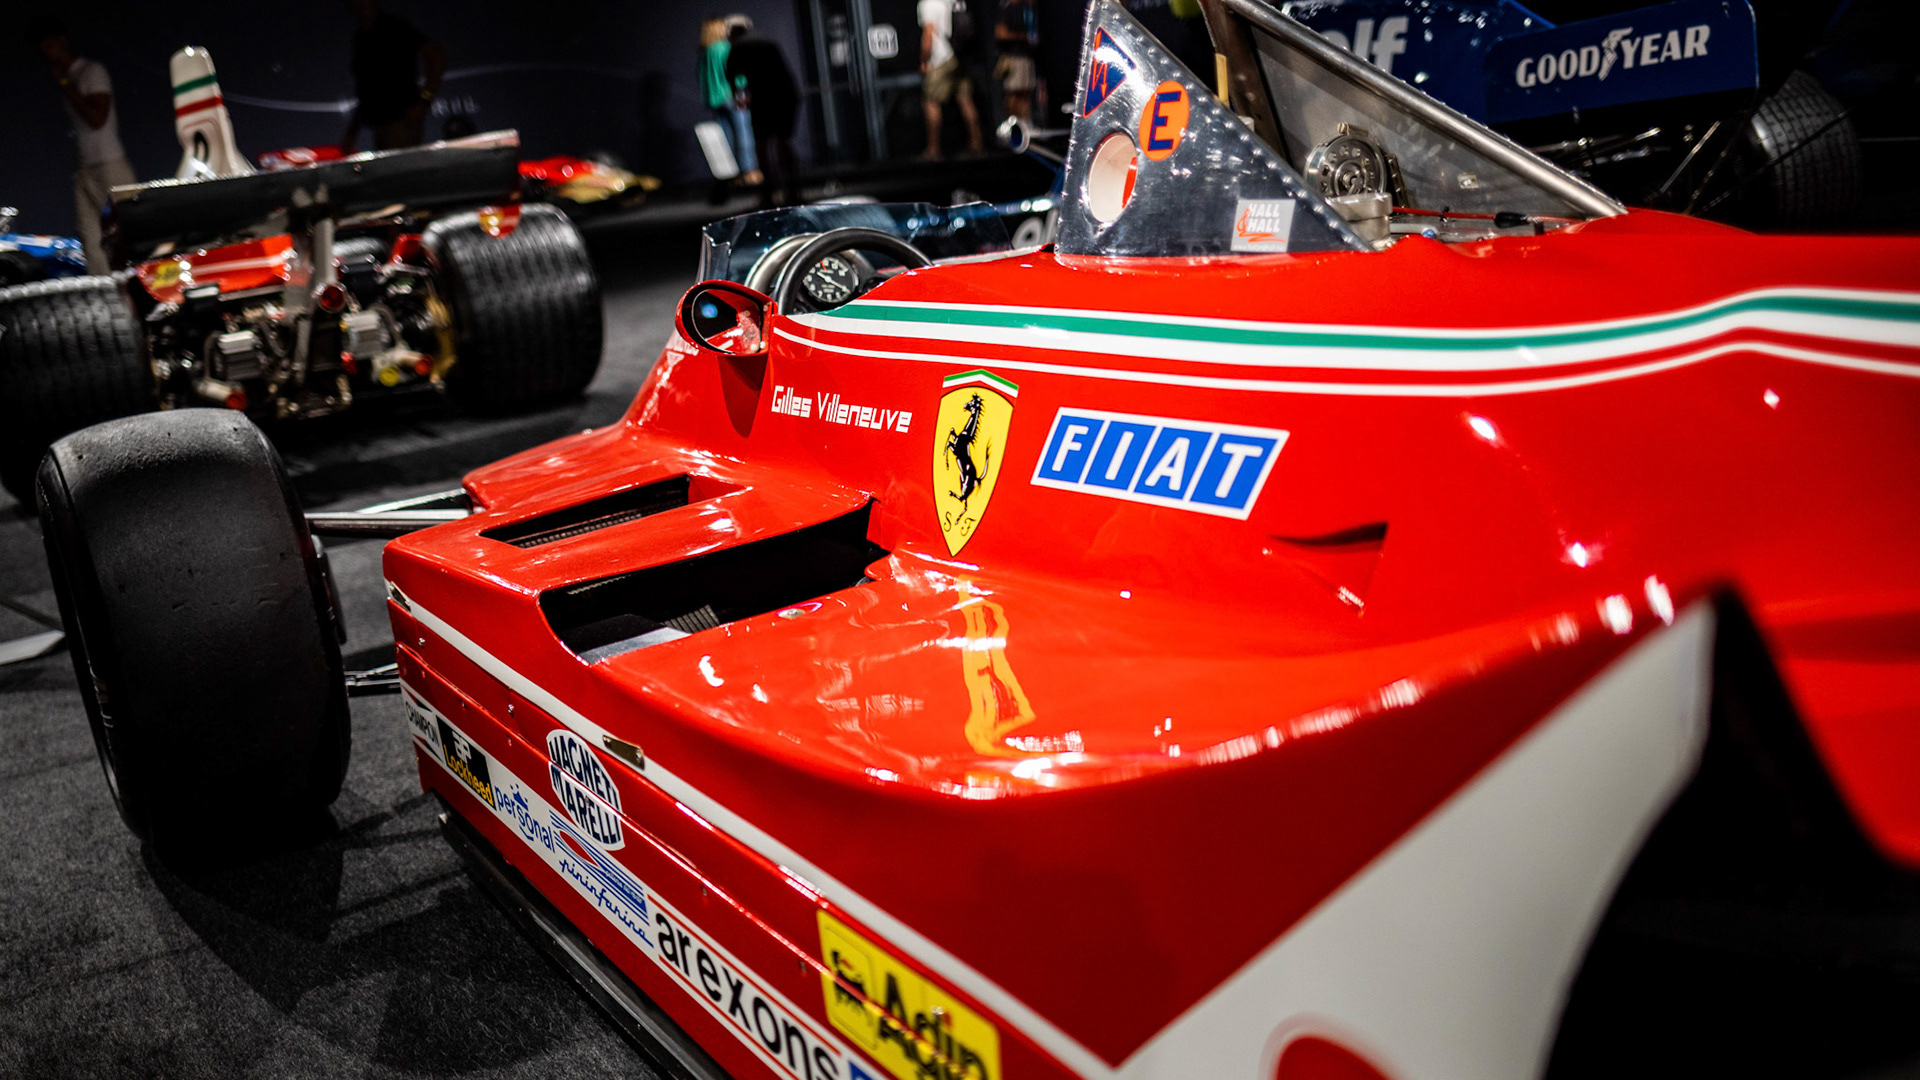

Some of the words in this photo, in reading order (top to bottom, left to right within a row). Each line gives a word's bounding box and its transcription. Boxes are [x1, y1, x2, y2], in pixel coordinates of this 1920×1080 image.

[1317, 16, 1409, 74] lf
[1147, 90, 1182, 152] E
[1246, 218, 1281, 233] HALL
[1247, 203, 1281, 218] HALL
[771, 385, 812, 418] Gilles
[817, 391, 913, 433] Villeneuve
[1051, 423, 1264, 499] FIAT
[443, 743, 494, 807] Lockheed
[548, 735, 621, 812] MAGNETI
[550, 764, 622, 845] MARELLI
[494, 785, 556, 854] personal
[558, 858, 656, 948] pininfarina
